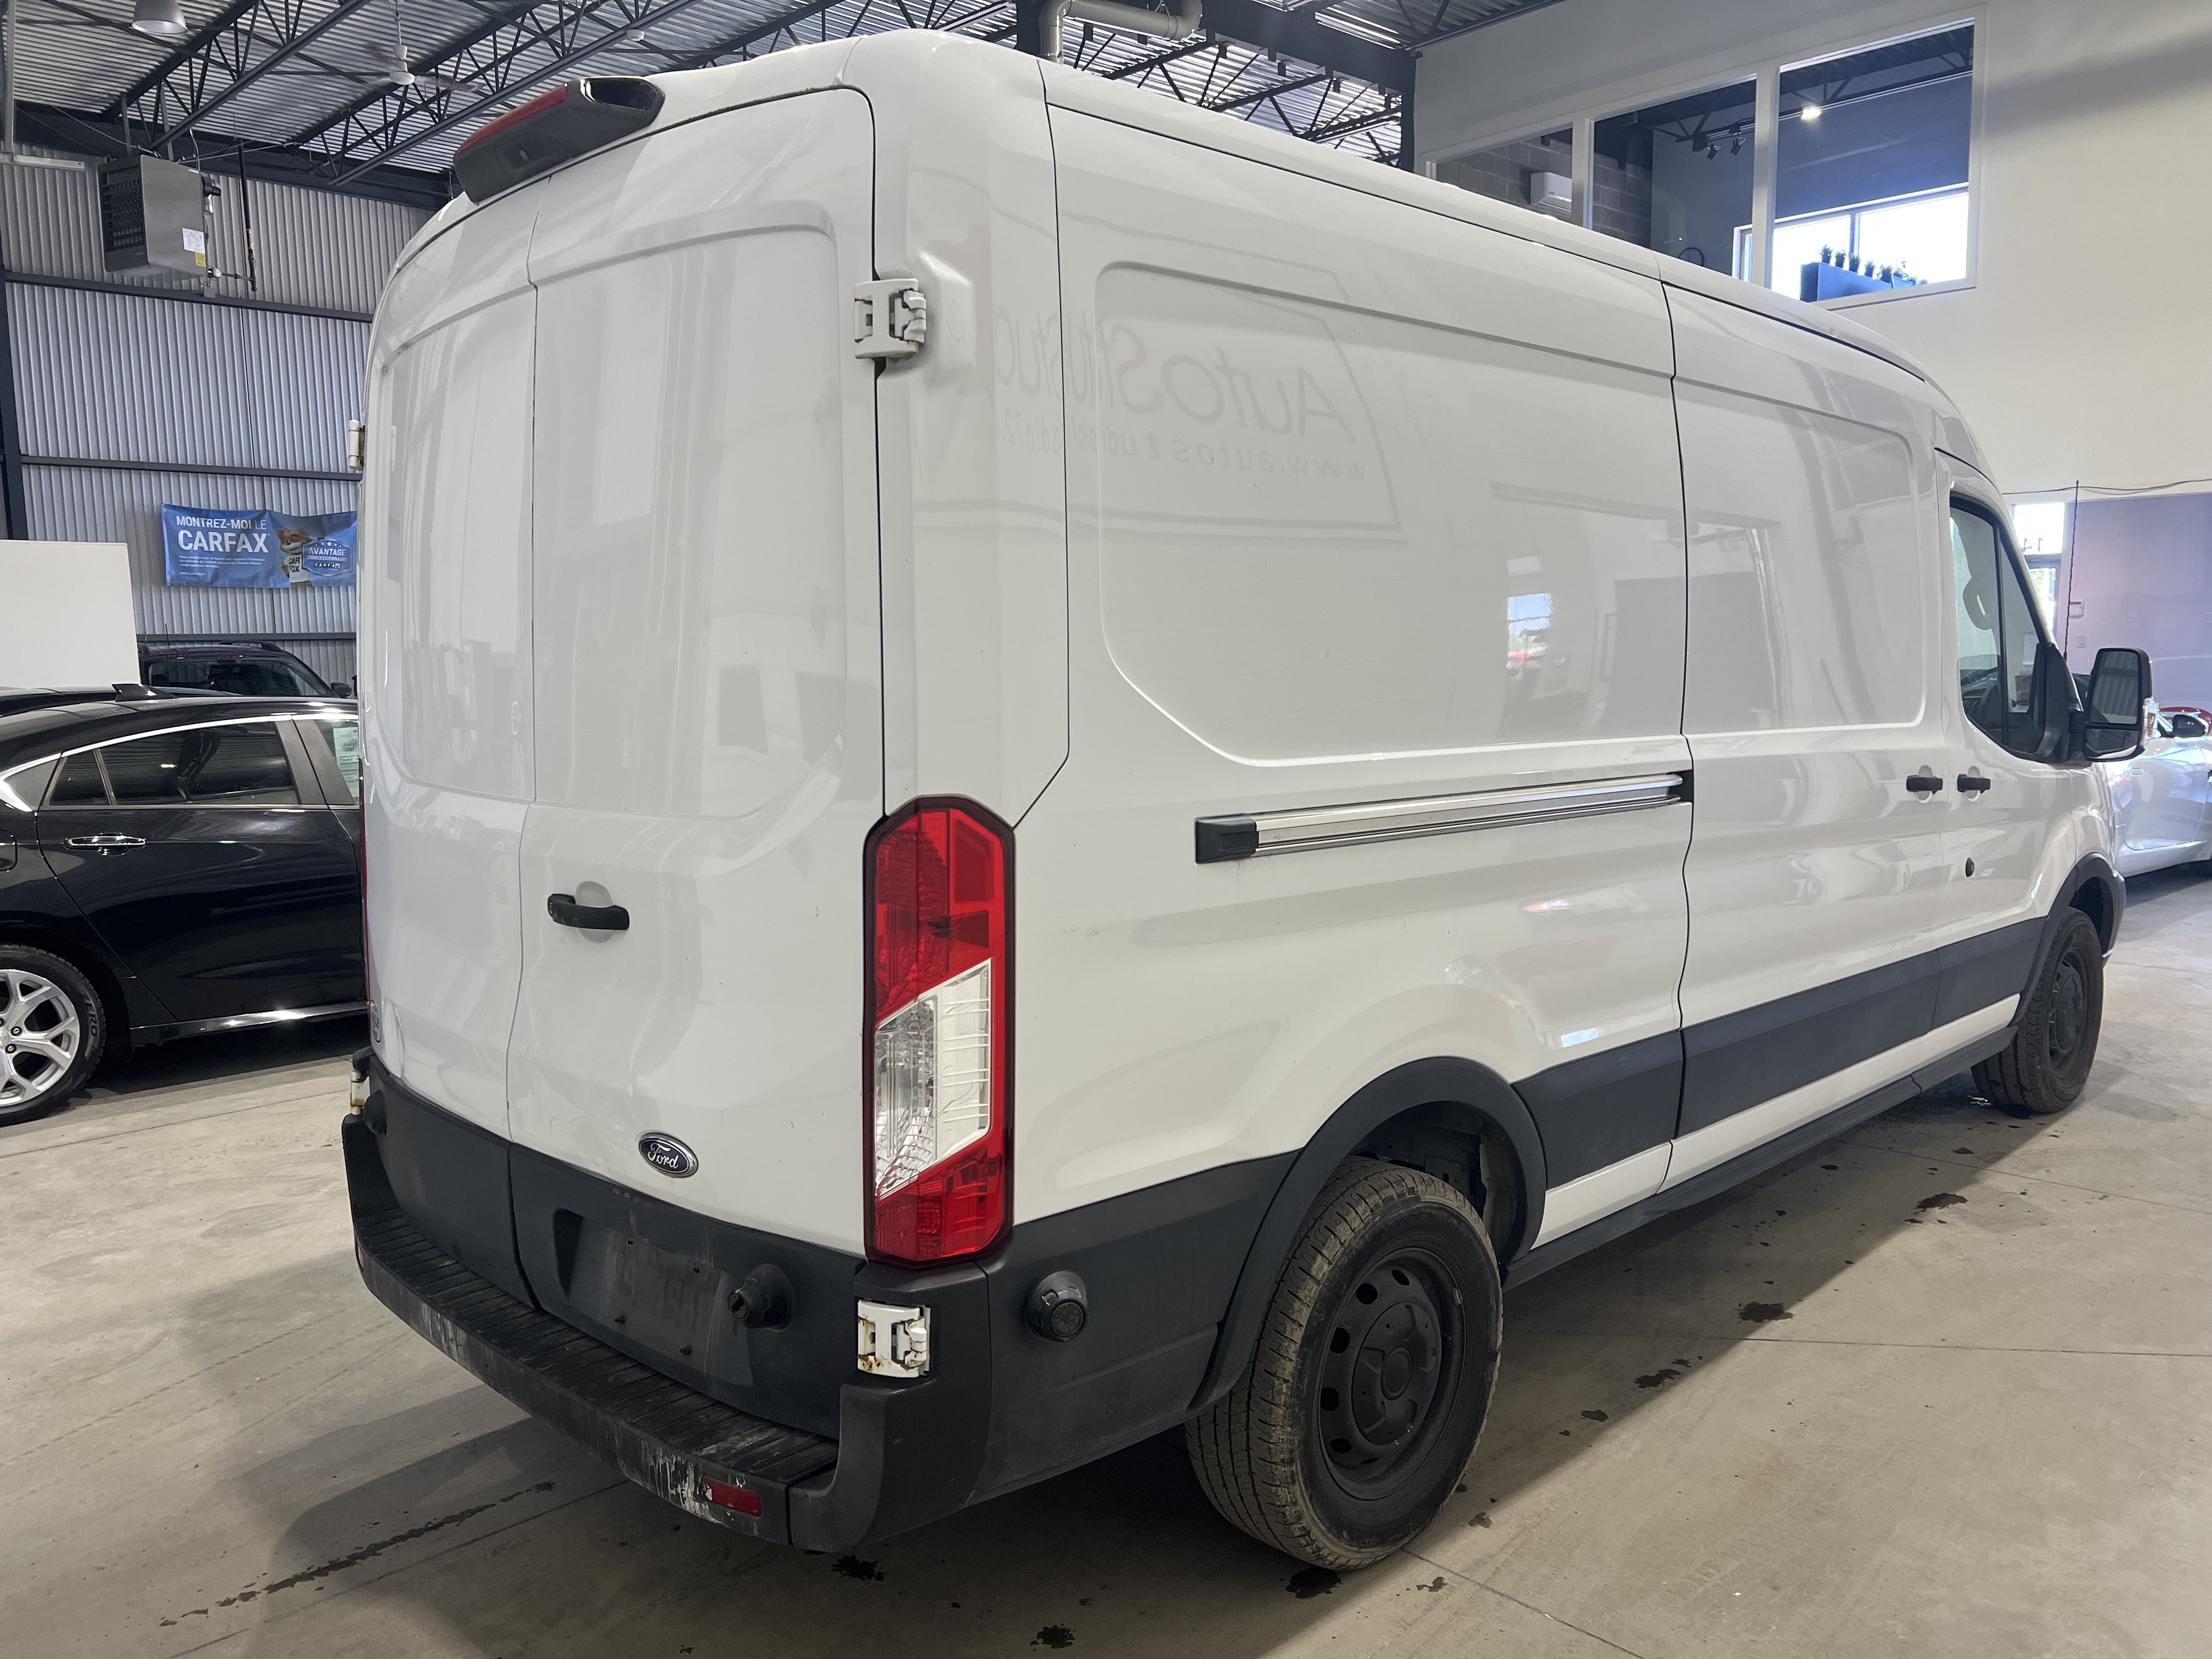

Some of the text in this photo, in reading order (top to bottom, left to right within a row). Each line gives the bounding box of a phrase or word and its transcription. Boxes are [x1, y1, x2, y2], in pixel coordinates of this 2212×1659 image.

[176, 515, 267, 530] MONTREZ-MOI LE
[178, 529, 269, 553] CARFAX
[308, 548, 346, 556] AVANTAGE
[647, 1143, 679, 1169] Ford
